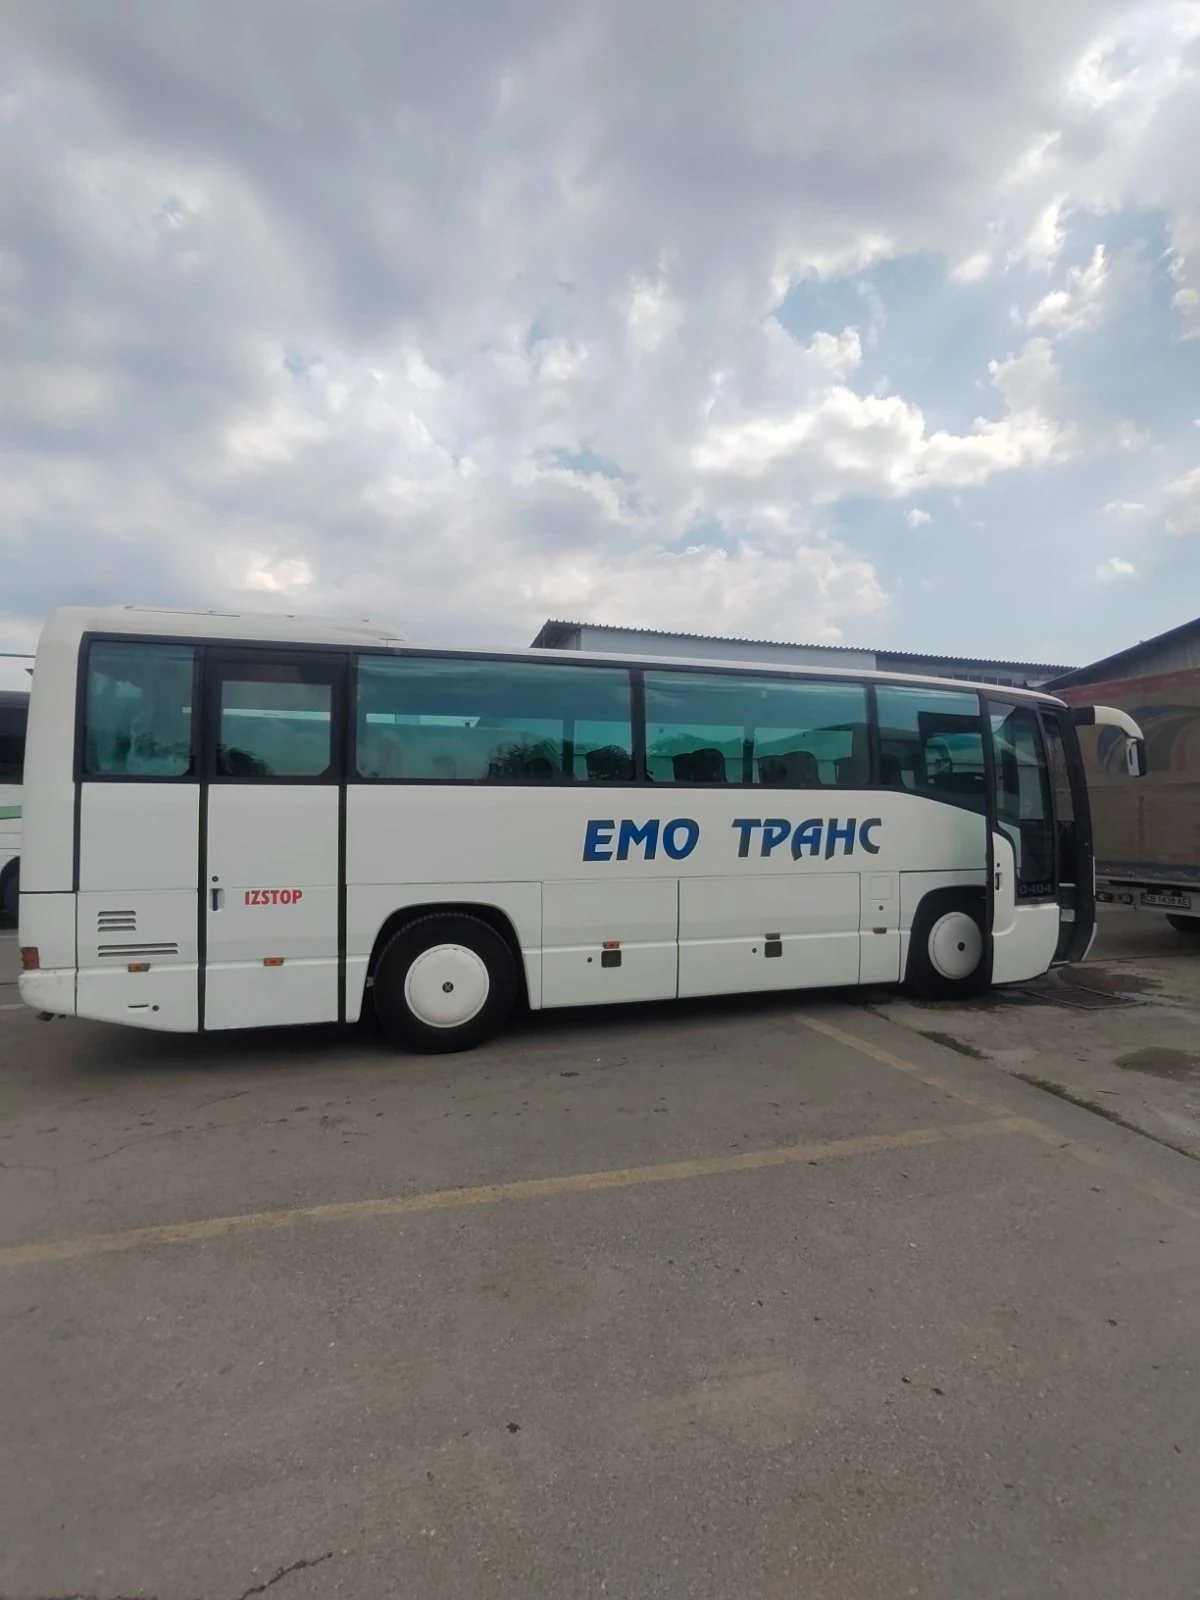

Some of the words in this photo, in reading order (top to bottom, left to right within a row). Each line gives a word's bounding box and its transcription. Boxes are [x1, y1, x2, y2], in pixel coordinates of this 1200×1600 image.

[582, 818, 700, 862] ЕМО
[731, 817, 882, 862] ТРАНС
[244, 889, 303, 905] IZSTOP
